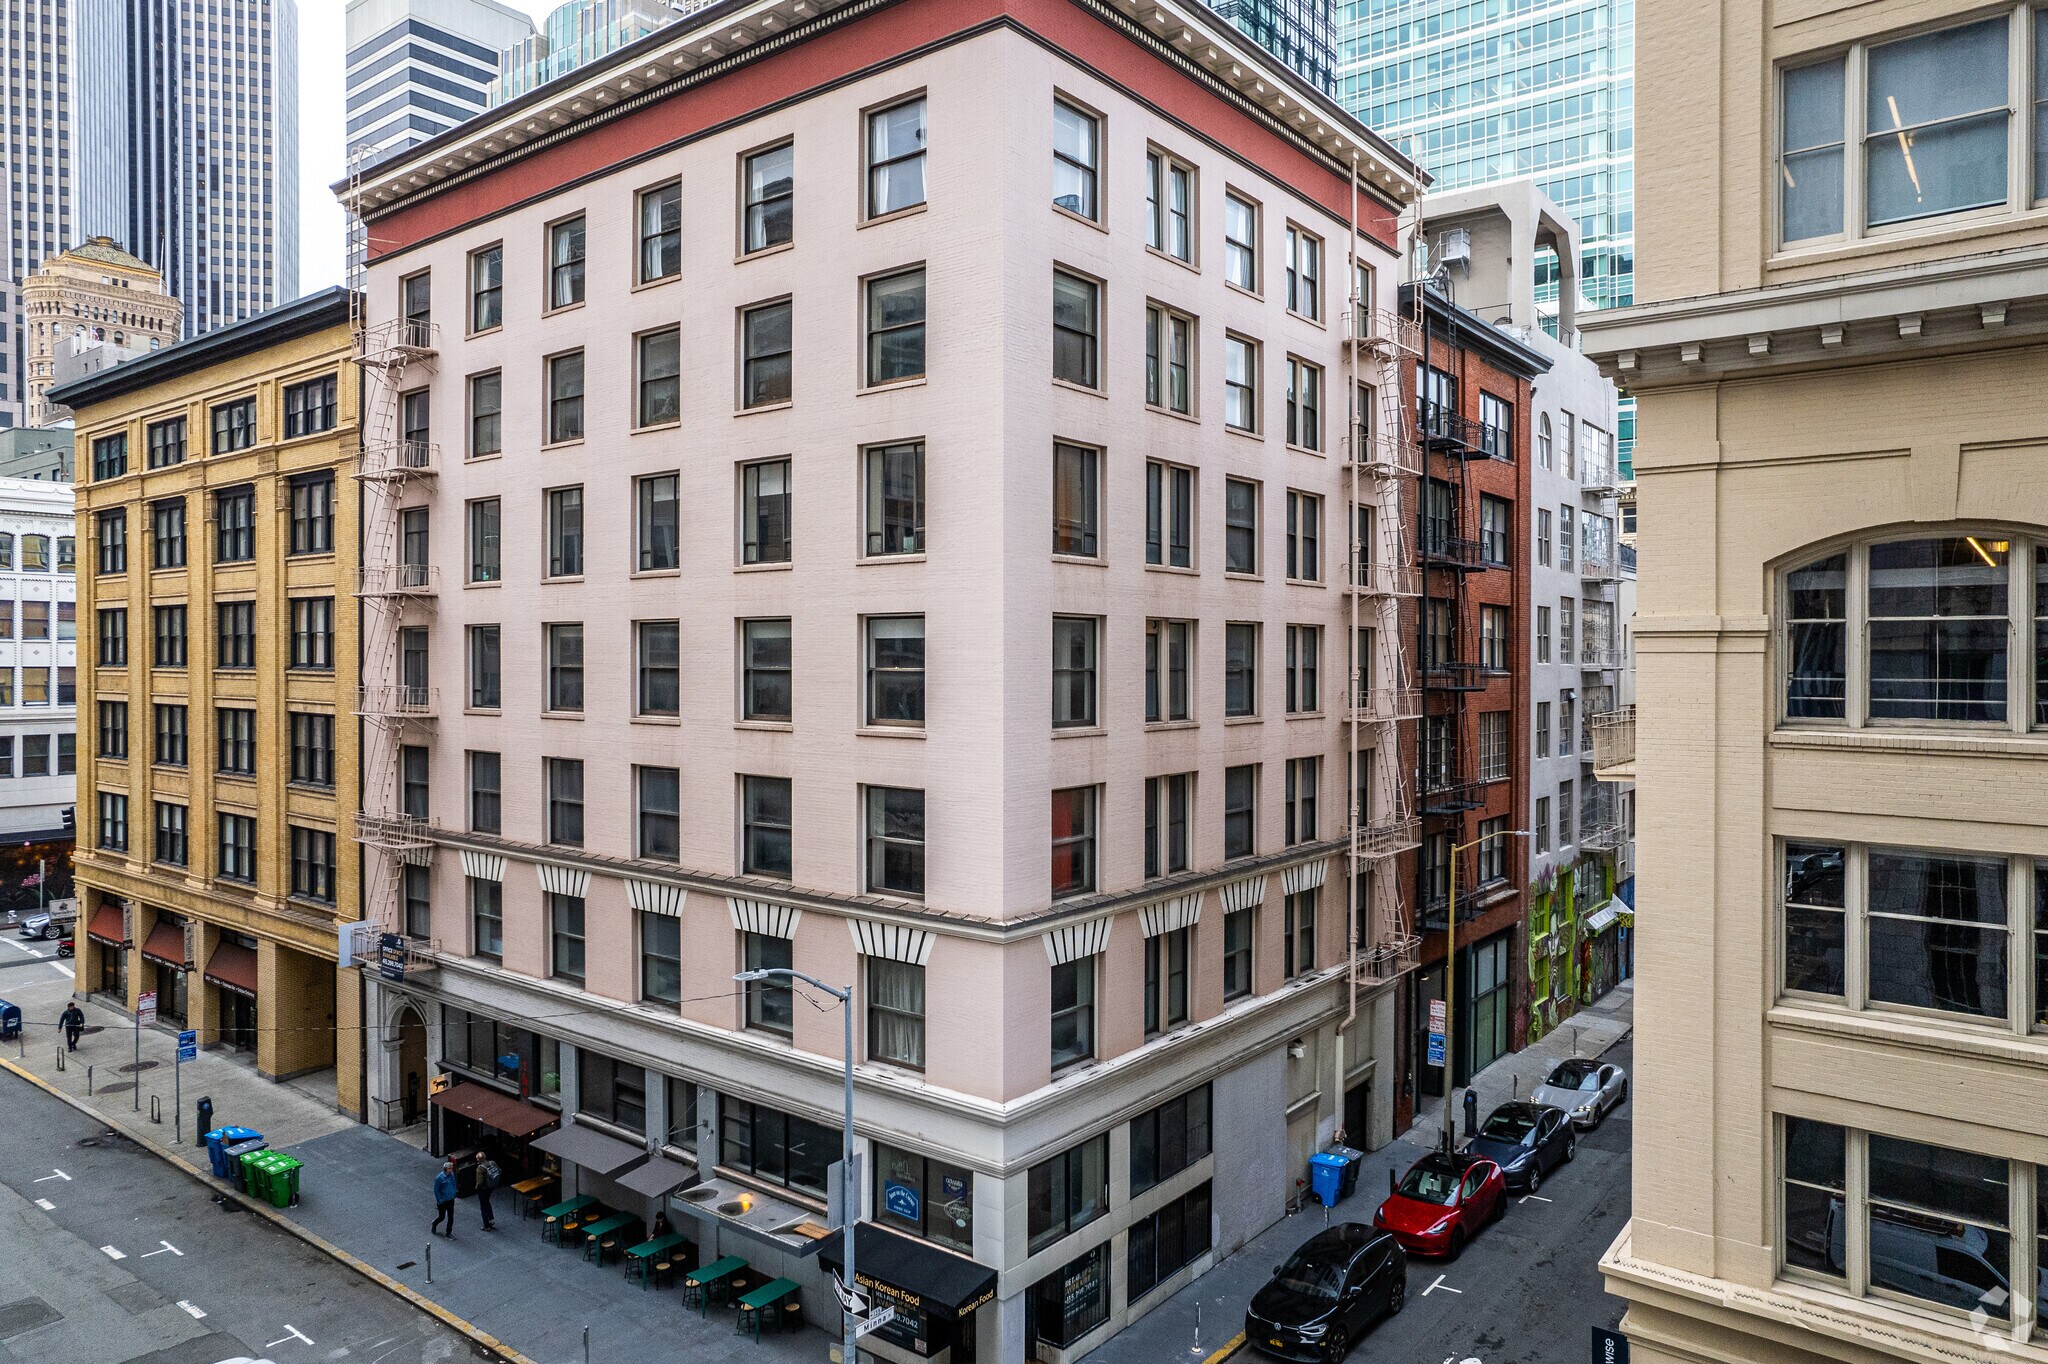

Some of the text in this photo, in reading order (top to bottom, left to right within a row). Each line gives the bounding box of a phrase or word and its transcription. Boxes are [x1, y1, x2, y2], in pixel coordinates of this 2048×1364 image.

[855, 1273, 920, 1306] Asian Korean Food
[959, 1289, 994, 1318] Korean Food
[863, 1315, 887, 1332] Minna
